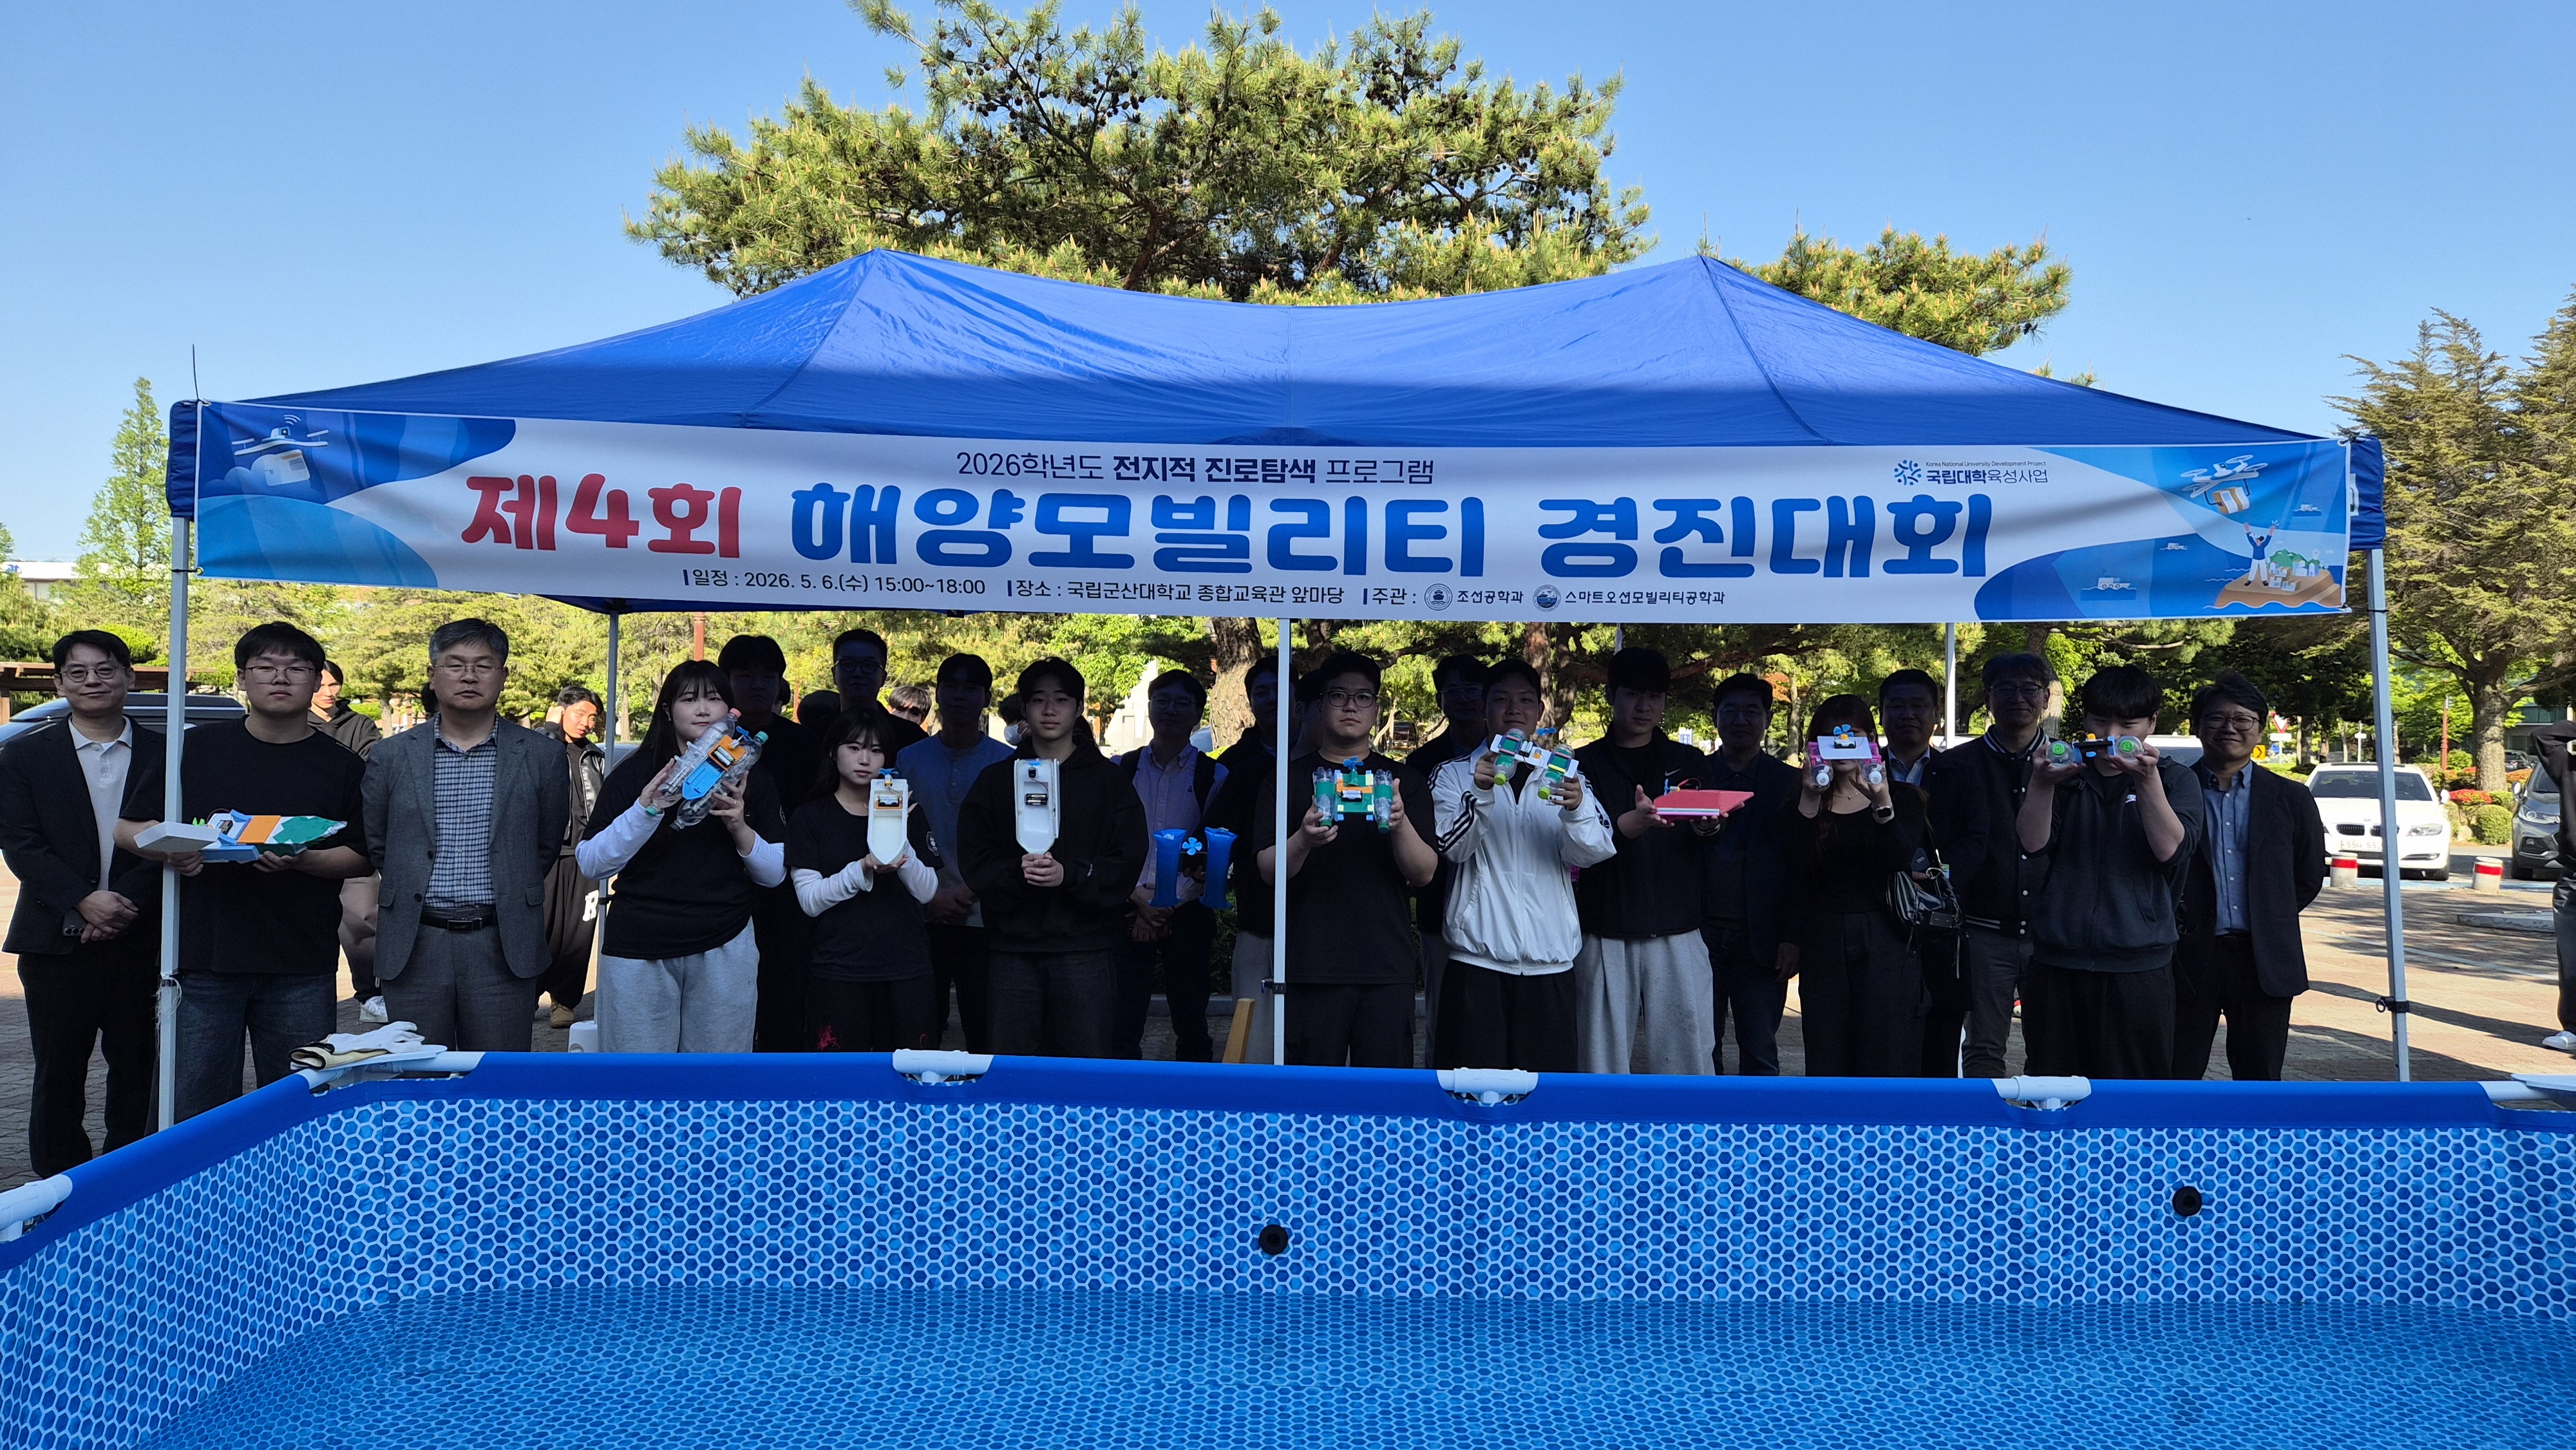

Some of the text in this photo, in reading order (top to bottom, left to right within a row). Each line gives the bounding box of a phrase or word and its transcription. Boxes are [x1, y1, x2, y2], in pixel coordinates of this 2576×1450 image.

[956, 451, 1434, 484] 2026학년도 전지적 진로탐색 프로그램
[1926, 469, 2048, 485] 국립대학육성사업
[461, 473, 1992, 578] 제4회 해양모빌리티 경진대회
[692, 569, 728, 587] 일정
[744, 572, 795, 588] 2026.
[800, 574, 817, 589] 5.
[822, 574, 868, 592] 6.(수)
[875, 576, 985, 594] 15:00~18:00
[1016, 579, 1052, 597] 장소
[1067, 581, 1191, 601] 국립군산대학교
[1197, 584, 1287, 603] 종합교육관
[1291, 586, 1345, 604] 앞마당
[1372, 588, 1408, 605] 주관
[1457, 590, 1524, 605] 조선공학과
[1565, 590, 1725, 605] 스마트오션모빌리티공학과
[582, 889, 599, 921] R
